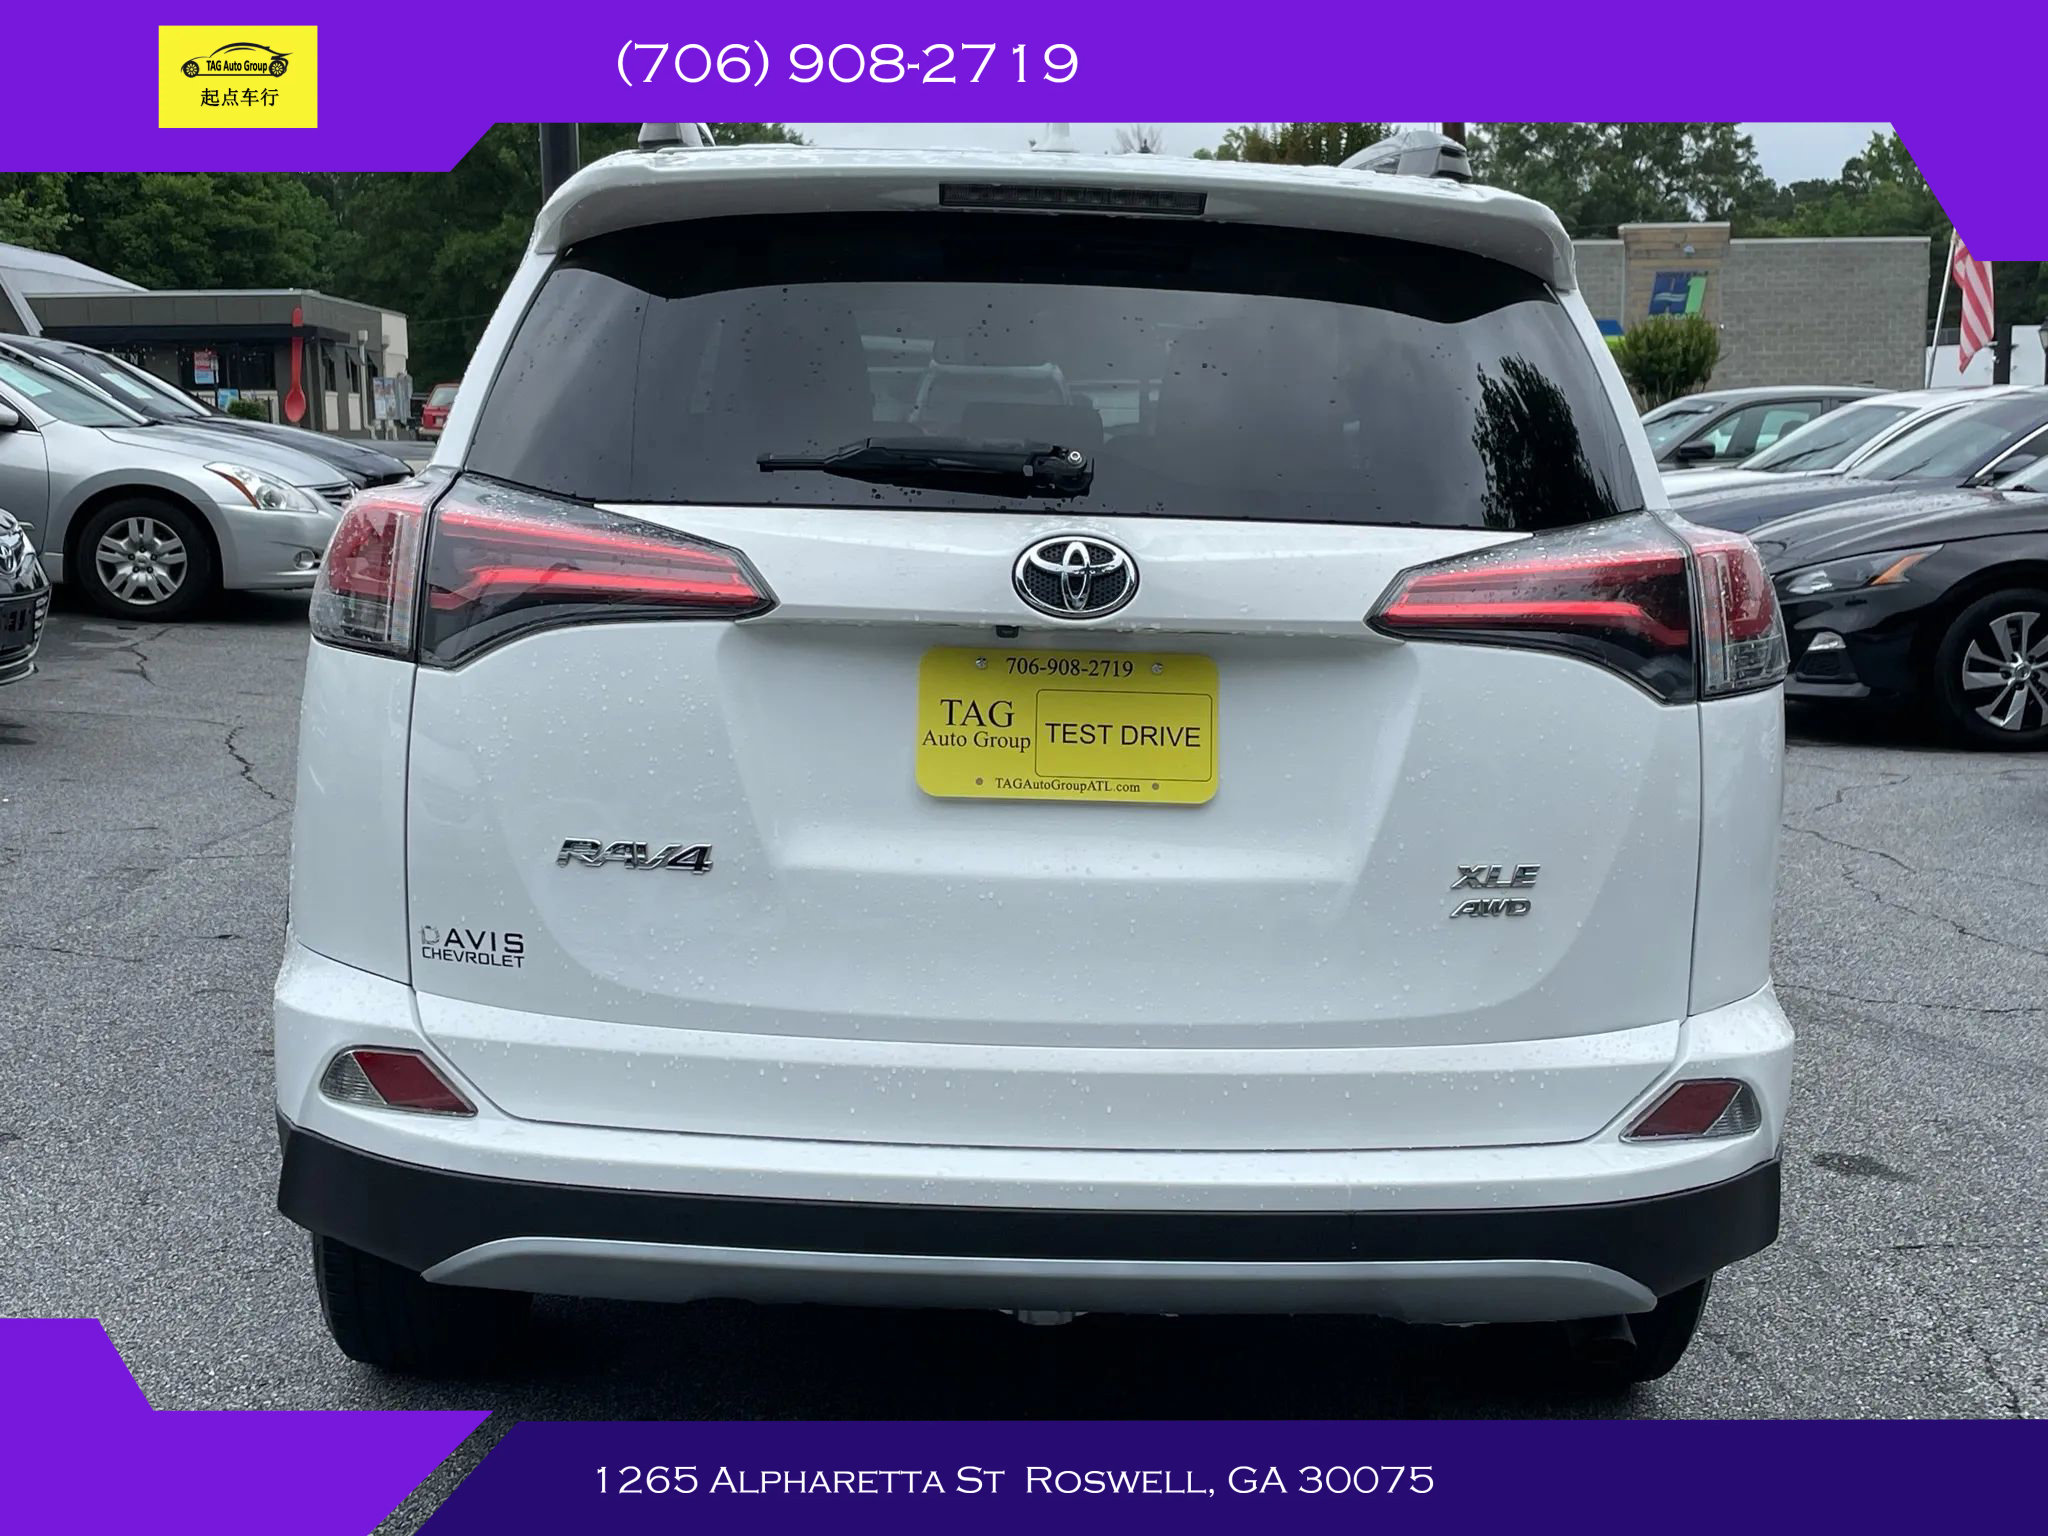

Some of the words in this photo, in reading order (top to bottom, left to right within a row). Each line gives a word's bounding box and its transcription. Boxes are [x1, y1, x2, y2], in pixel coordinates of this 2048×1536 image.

[1006, 657, 1133, 678] 706-908-2719
[940, 698, 1015, 728] TAG
[922, 729, 967, 748] Auto
[973, 731, 1031, 753] Group
[1045, 722, 1113, 745] TEST
[1121, 725, 1201, 748] DRIVE
[995, 777, 1141, 794] TAGAutoGroupATL.com
[556, 836, 714, 875] RAV4
[1450, 863, 1541, 890] XLE
[1449, 897, 1532, 919] AWD
[421, 925, 524, 954] DAVIS
[422, 946, 525, 969] CHEVROLET
